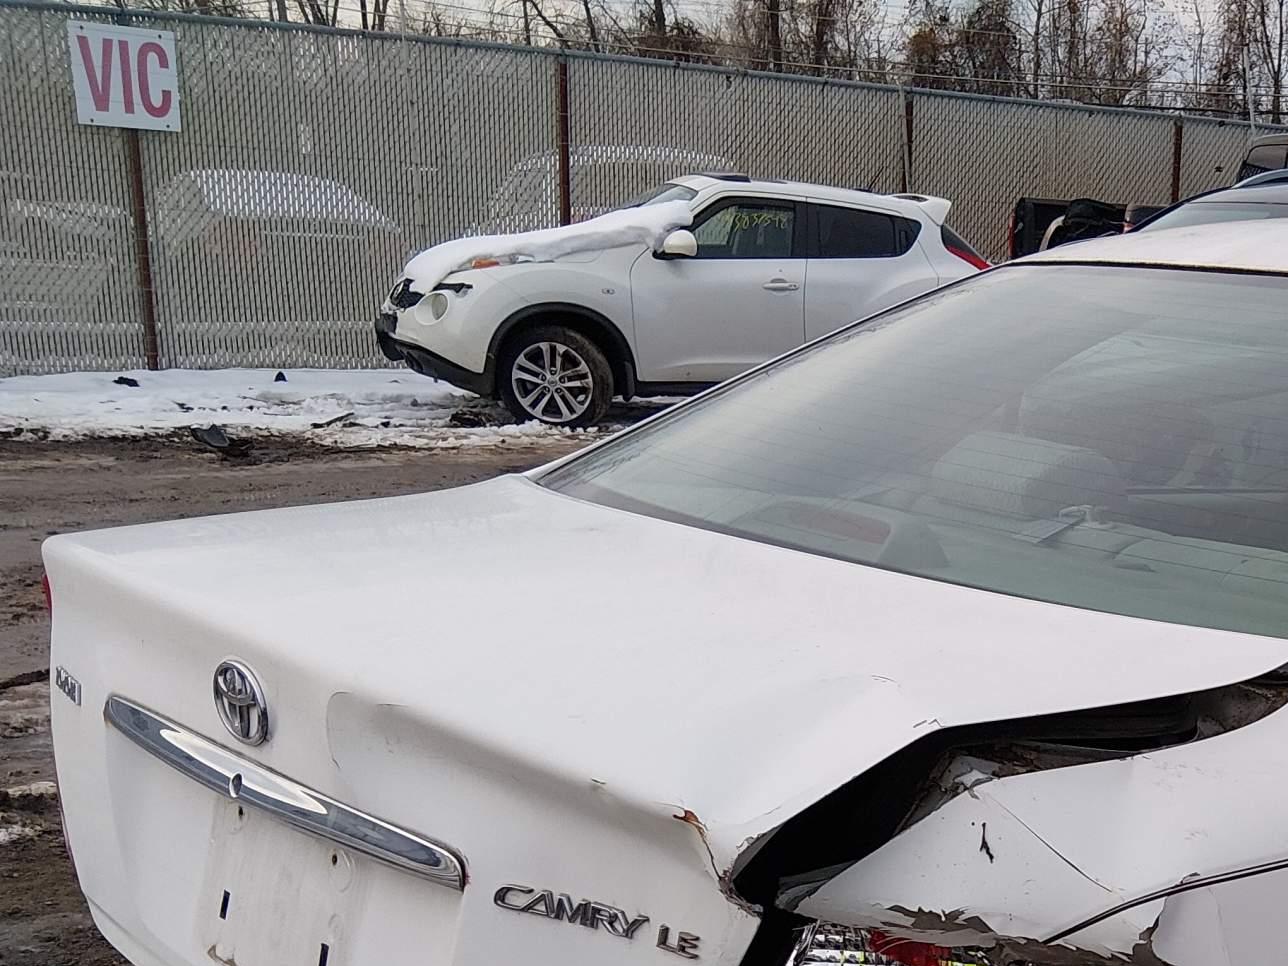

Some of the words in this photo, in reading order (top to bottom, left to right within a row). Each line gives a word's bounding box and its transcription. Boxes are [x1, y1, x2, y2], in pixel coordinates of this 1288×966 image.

[77, 35, 171, 117] VIC
[494, 884, 649, 939] CAMRY
[656, 924, 700, 959] LE
